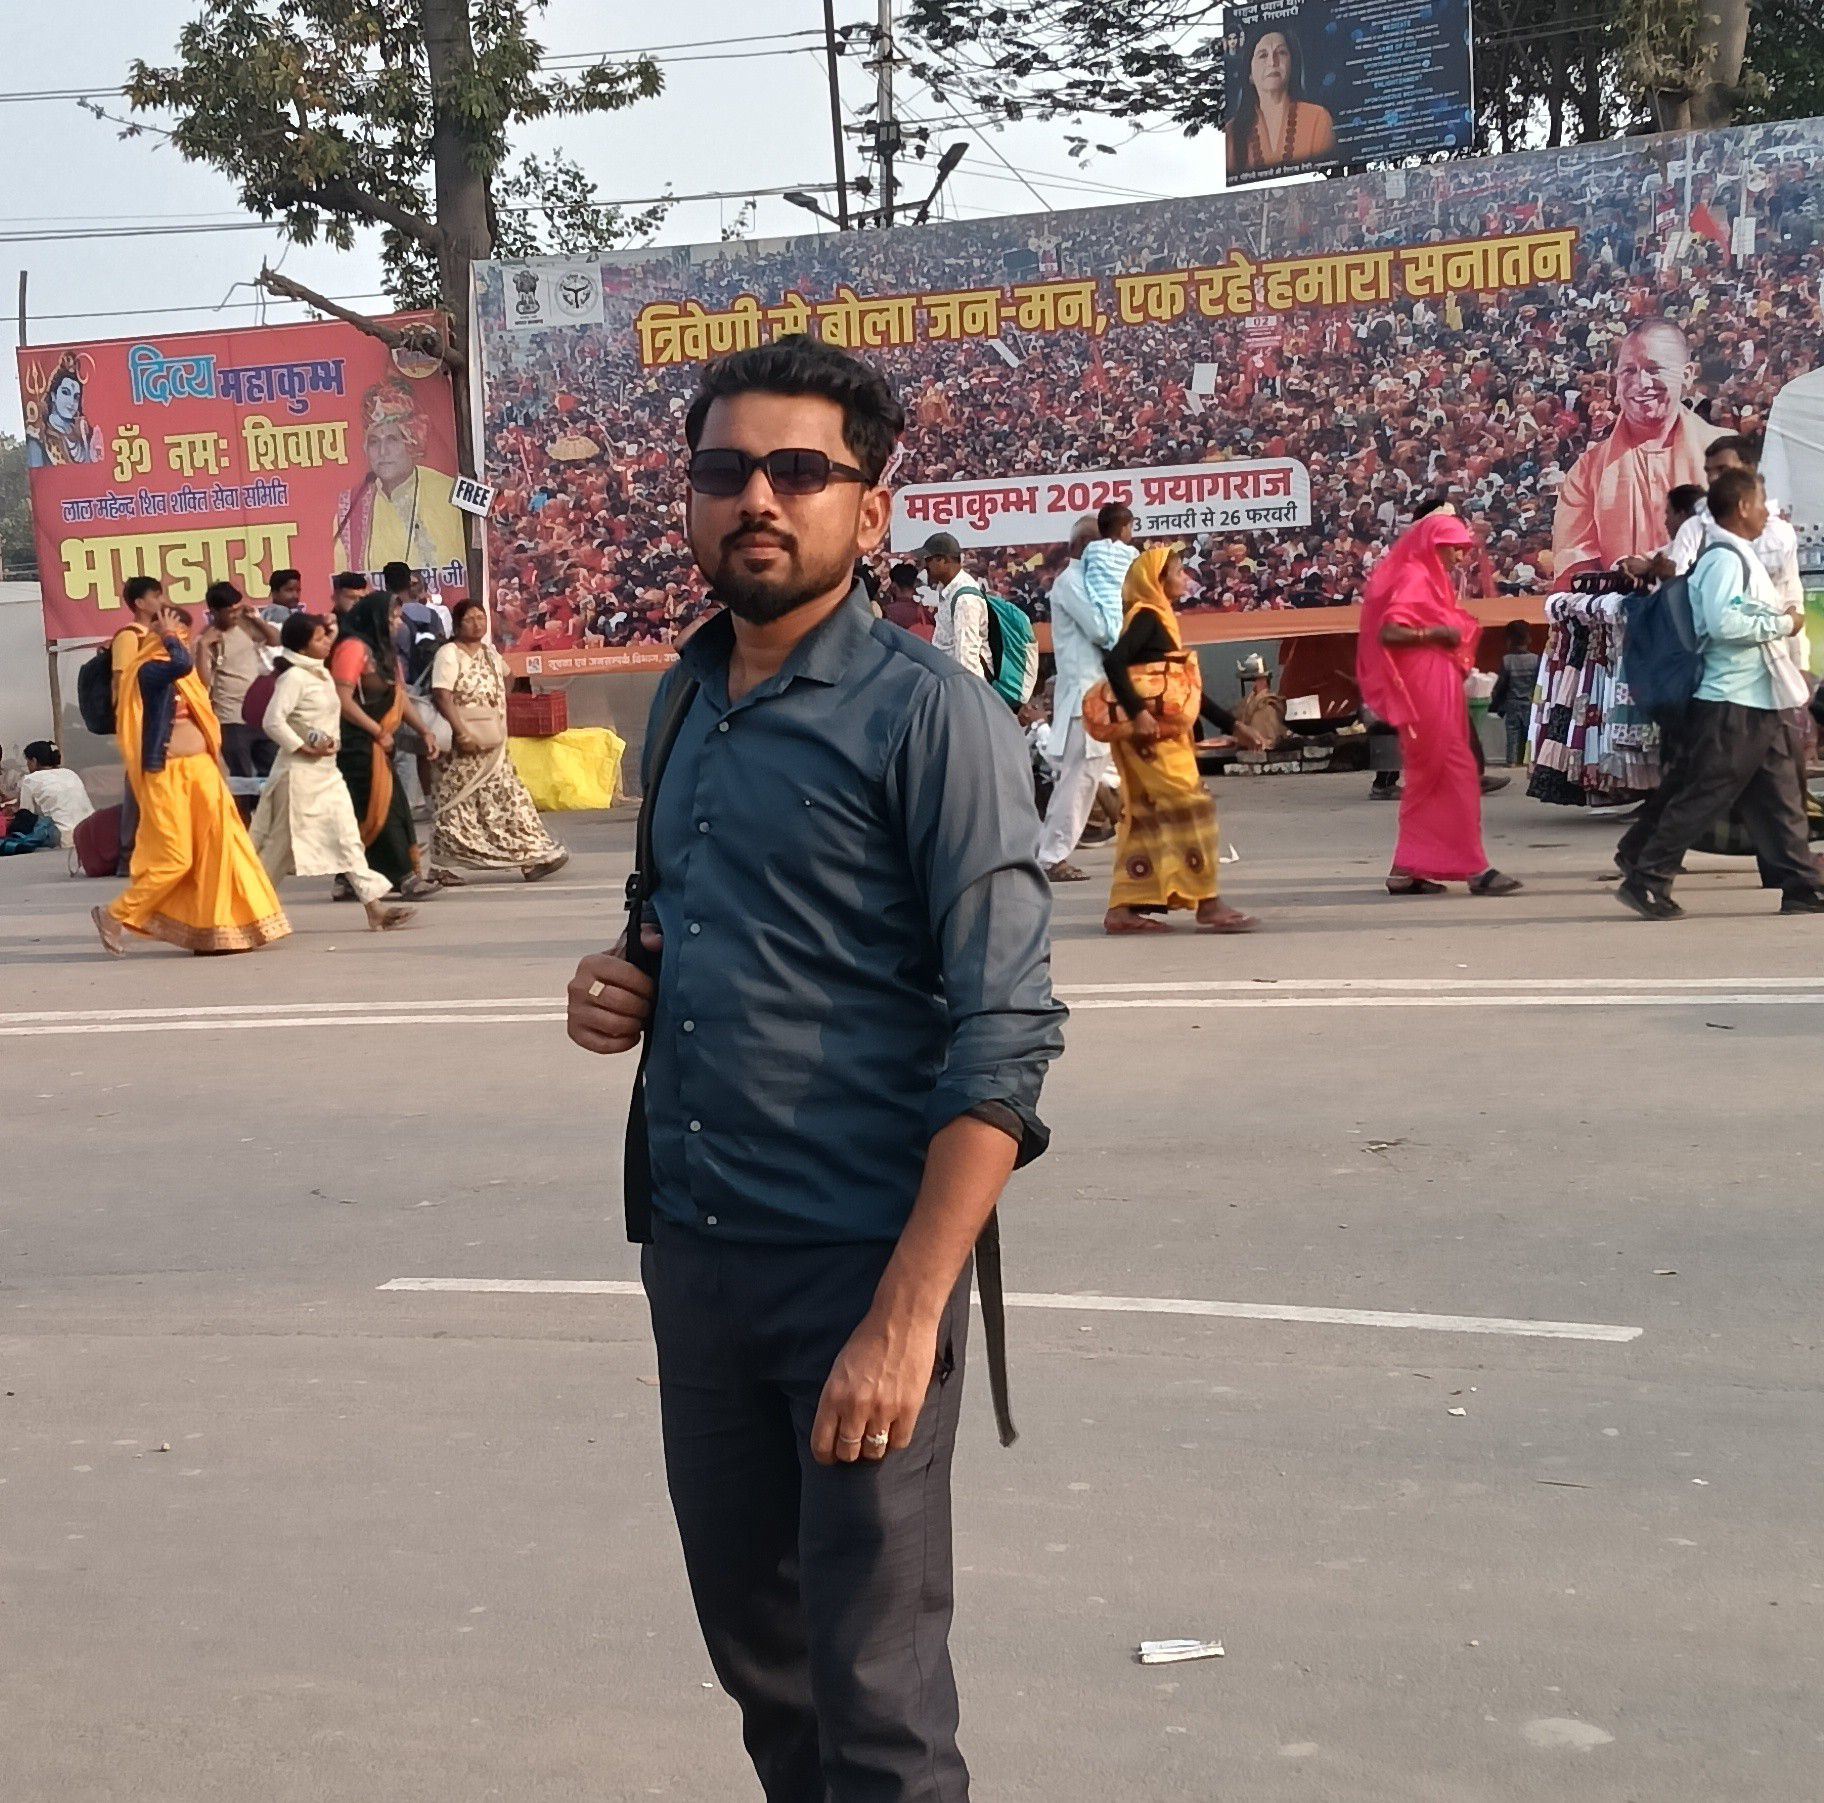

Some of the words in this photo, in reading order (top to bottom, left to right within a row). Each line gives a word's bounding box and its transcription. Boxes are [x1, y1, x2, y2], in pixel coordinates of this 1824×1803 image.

[636, 297, 763, 365] त्रिवेणी
[816, 287, 917, 348] बोला
[921, 280, 1108, 336] जन-मन,
[1115, 271, 1189, 322] एक
[1195, 252, 1256, 317] रहे
[1262, 250, 1394, 310] हमारा
[1401, 231, 1575, 296] सनातन
[128, 345, 216, 406] दिव्य
[217, 358, 346, 416] महाकुम्भ
[241, 415, 349, 473] शिवाय
[62, 498, 94, 524] लाल
[138, 485, 168, 516] शिव
[170, 483, 208, 513] शक्ति
[211, 483, 240, 511] सेवा
[242, 476, 290, 508] समिति
[456, 479, 491, 508] FREE
[904, 485, 1039, 530] महाकुम्भ
[1047, 479, 1133, 513] 2025
[1140, 467, 1293, 507] प्रयागराज
[1146, 507, 1196, 530] जनवरी
[1200, 506, 1216, 528] से
[1219, 508, 1241, 527] 26
[1245, 500, 1298, 524] फरवरी
[441, 558, 465, 588] जी
